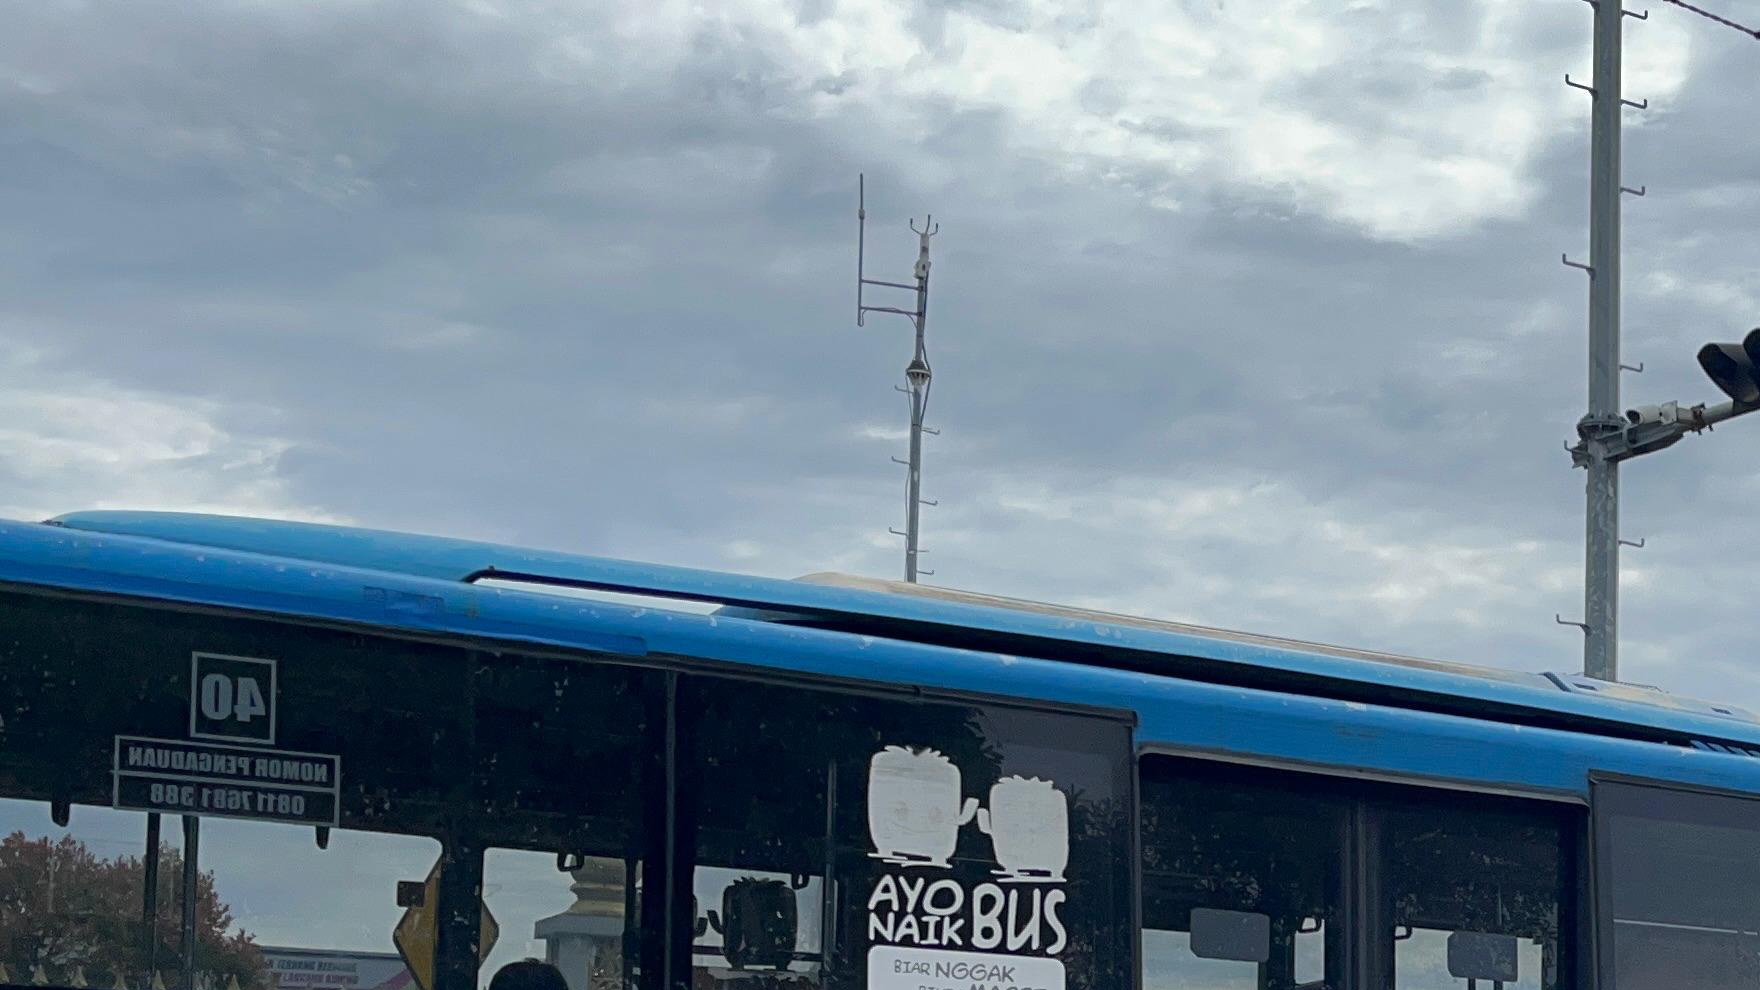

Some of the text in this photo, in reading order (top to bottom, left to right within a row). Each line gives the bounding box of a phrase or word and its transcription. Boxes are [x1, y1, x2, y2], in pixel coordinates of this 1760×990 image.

[867, 874, 965, 915] AYO
[868, 882, 1067, 955] NAIK BUS
[894, 959, 1016, 983] BIAR NGGAK
